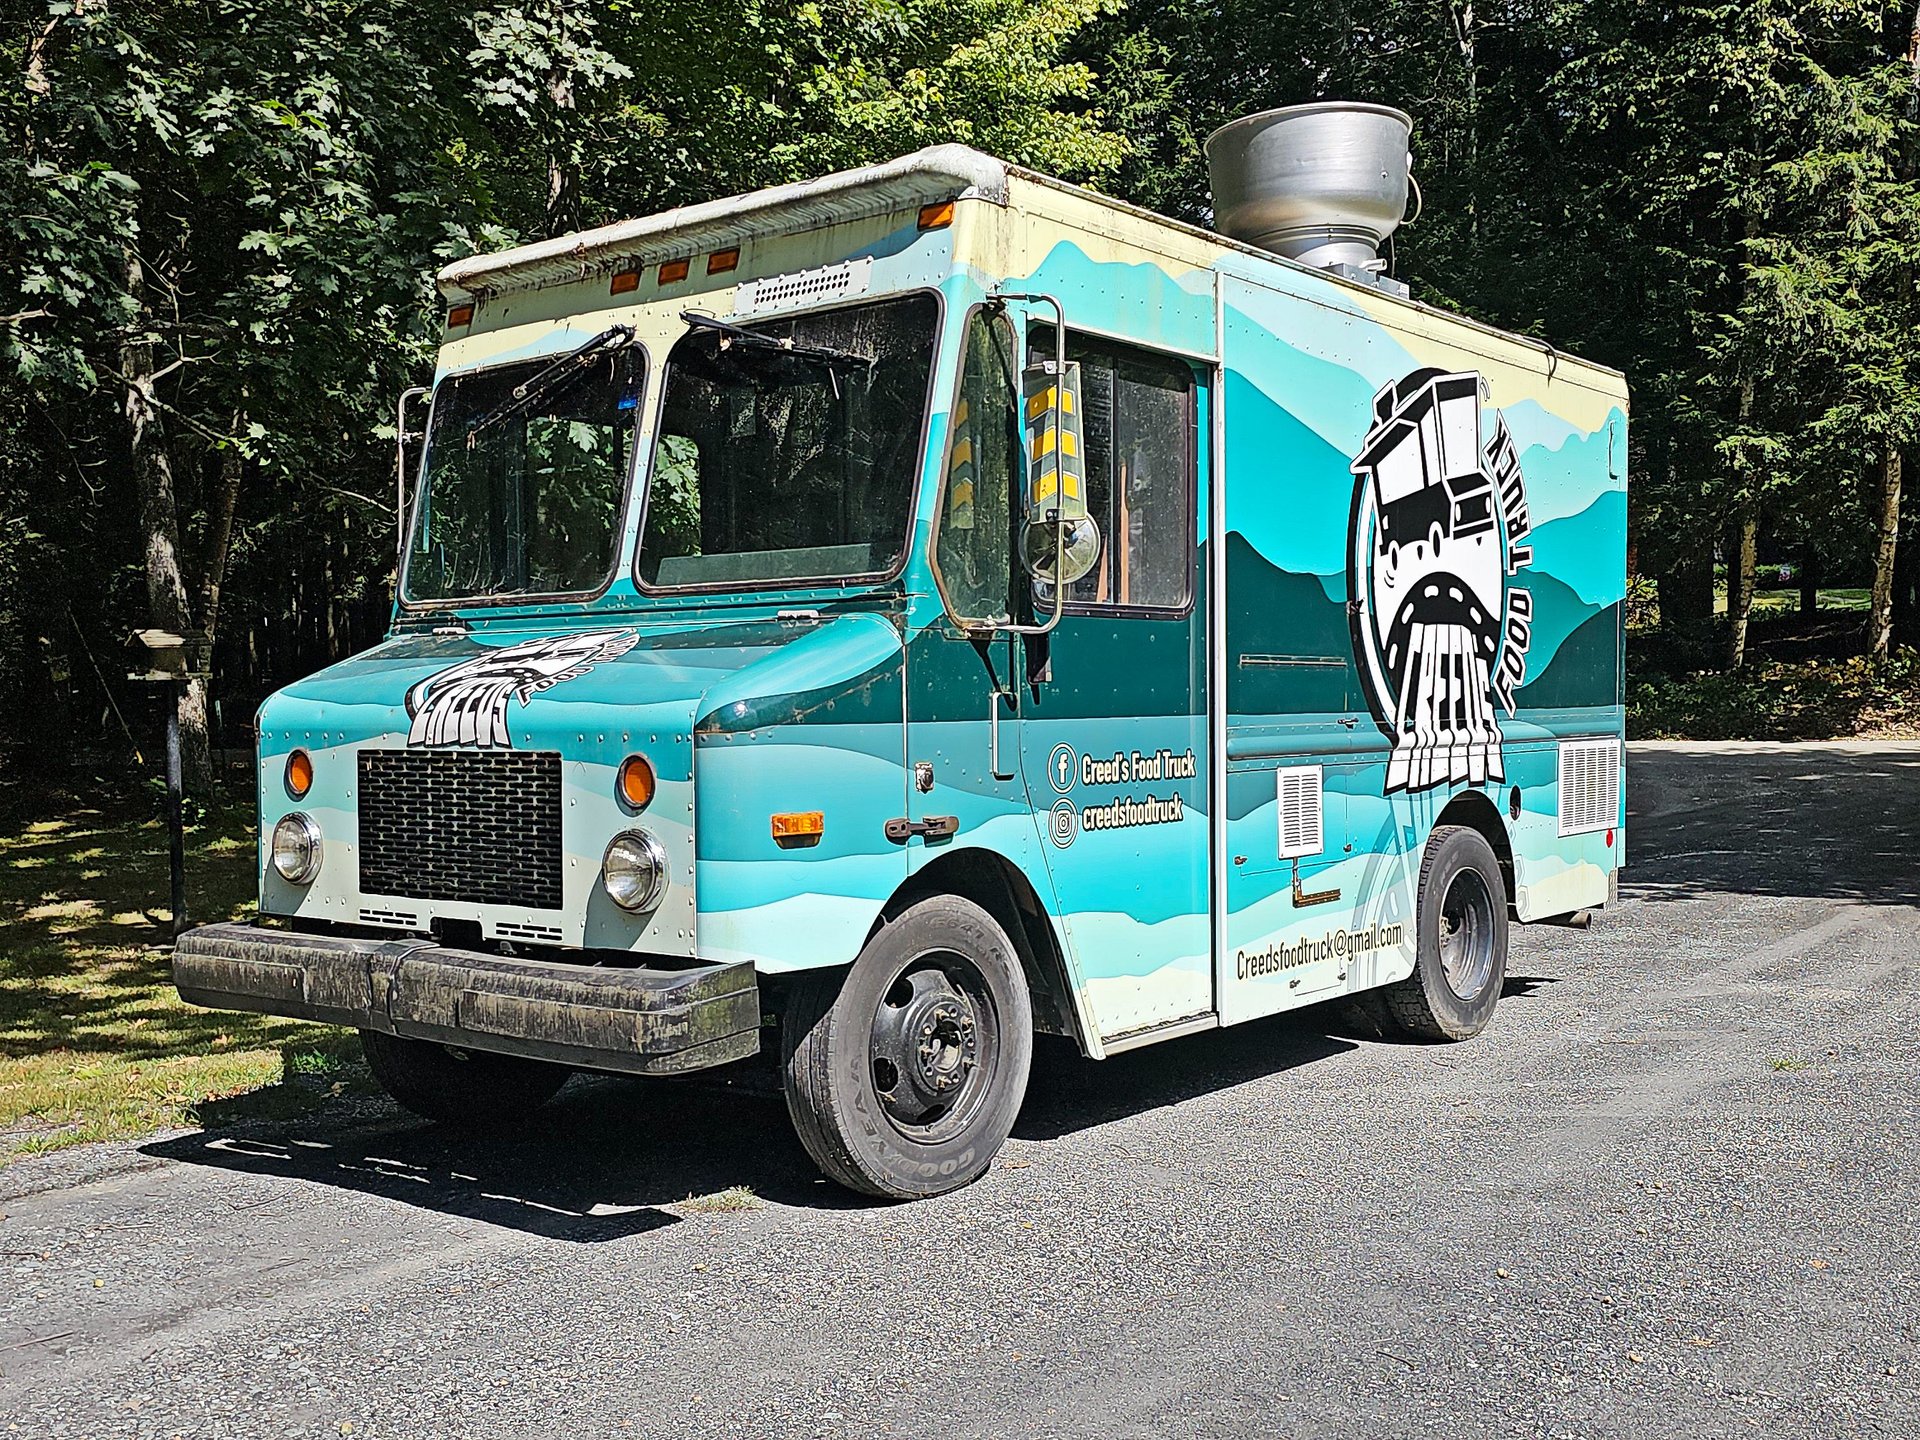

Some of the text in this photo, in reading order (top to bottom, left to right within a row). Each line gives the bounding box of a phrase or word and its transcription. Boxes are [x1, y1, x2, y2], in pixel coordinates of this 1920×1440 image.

[1484, 412, 1532, 717] FOOD TRUCK
[517, 667, 593, 706] FOOD
[1082, 749, 1196, 785] Creed's Food Truck
[1082, 792, 1183, 831] creedsfoodtruck
[1237, 923, 1402, 980] Creedsfoodtruck@gmail.com
